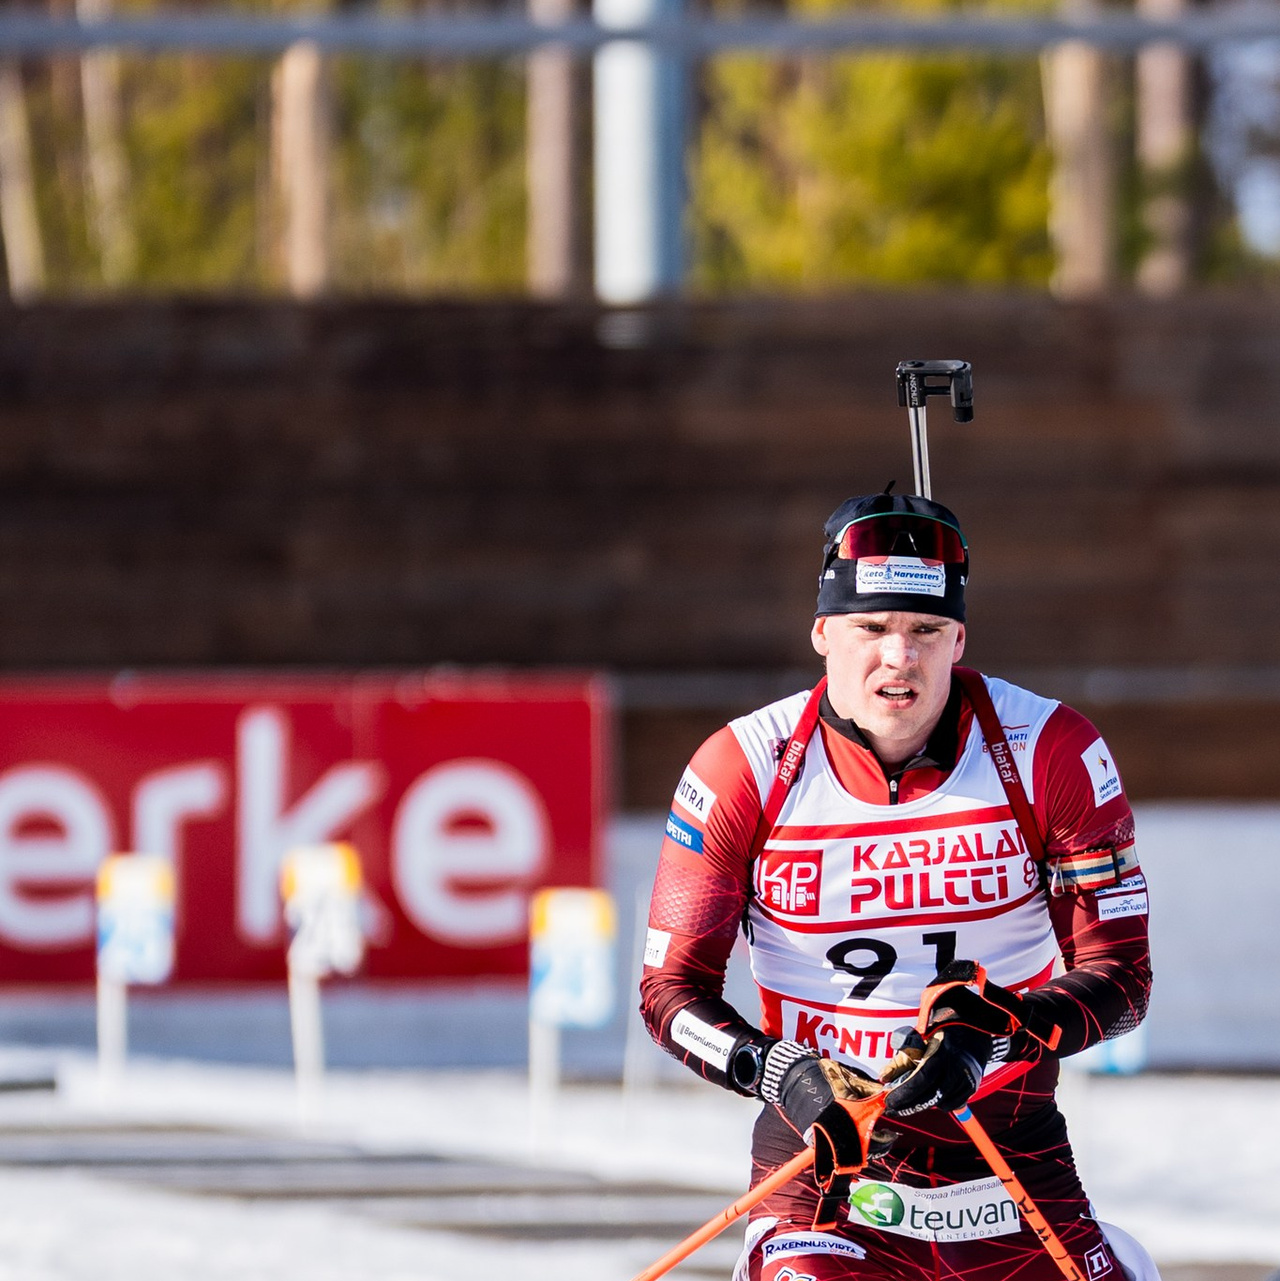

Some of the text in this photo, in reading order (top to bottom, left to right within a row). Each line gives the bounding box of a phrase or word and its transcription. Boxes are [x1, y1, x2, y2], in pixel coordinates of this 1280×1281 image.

[893, 571, 940, 581] Harvesters
[778, 740, 806, 786] biatar
[991, 741, 1015, 784] biatar
[0, 707, 552, 949] erke
[825, 931, 957, 1001] 91
[909, 1198, 1018, 1231] teuvan
[913, 1190, 949, 1201] Soppaa
